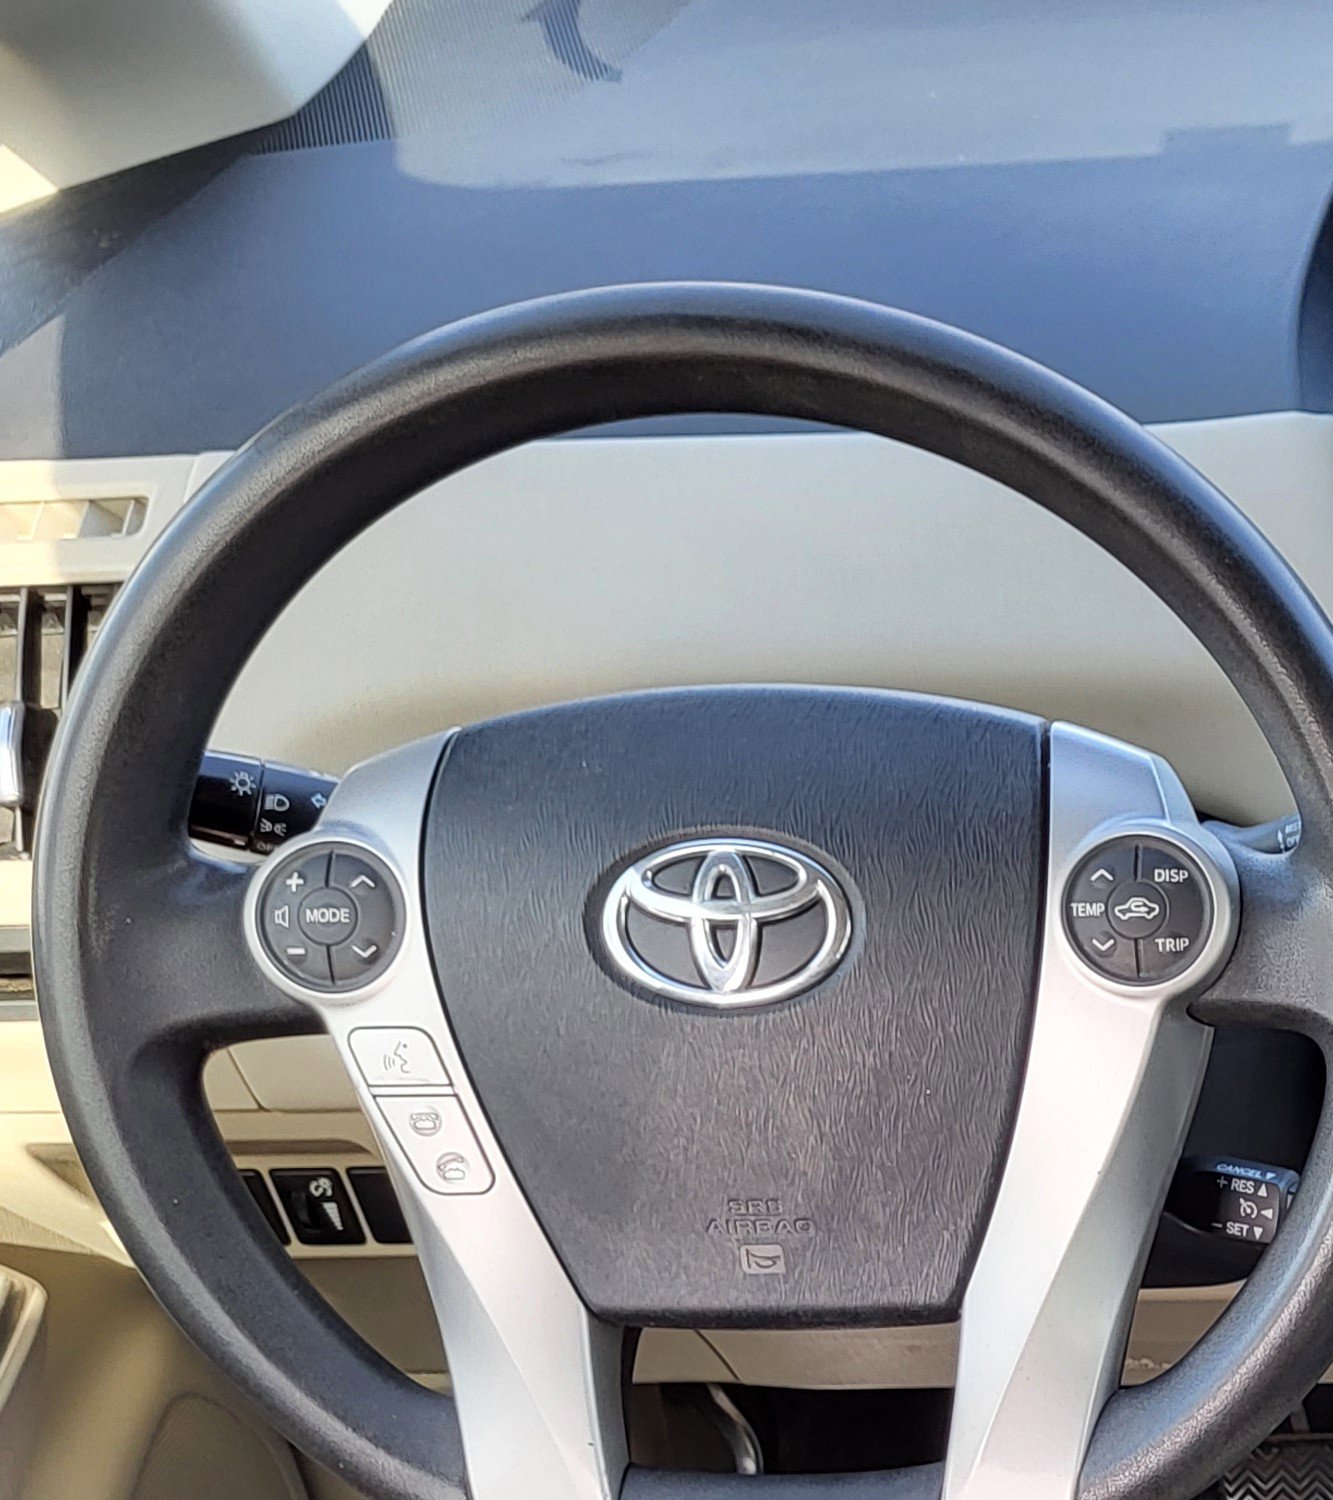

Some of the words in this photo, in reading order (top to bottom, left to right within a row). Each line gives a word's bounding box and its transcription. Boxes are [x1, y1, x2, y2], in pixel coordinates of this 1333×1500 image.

[1154, 868, 1189, 883] DISP
[305, 908, 350, 924] MODE
[1070, 902, 1105, 917] TEMP
[1155, 938, 1190, 952] TRIP
[1216, 1163, 1262, 1179] CANCEL
[1230, 1178, 1255, 1194] RES
[1225, 1221, 1250, 1238] SET
